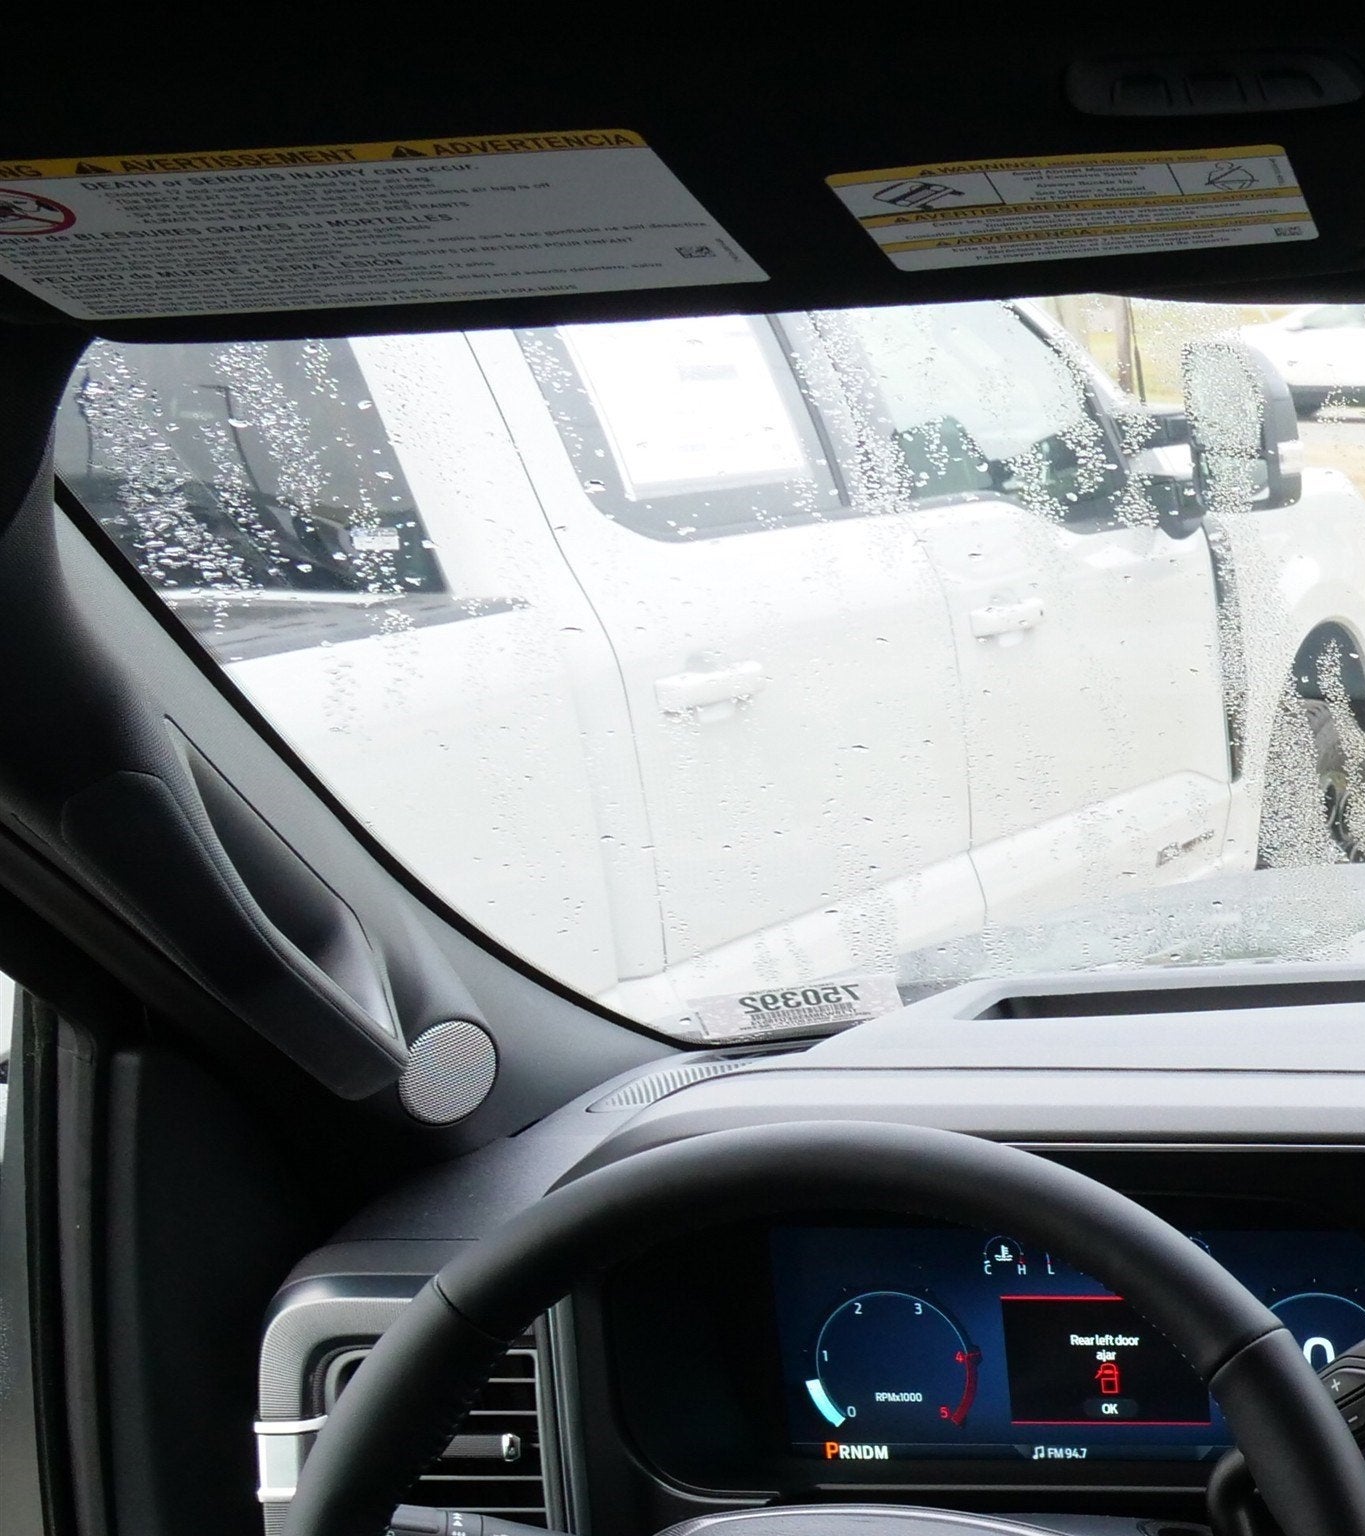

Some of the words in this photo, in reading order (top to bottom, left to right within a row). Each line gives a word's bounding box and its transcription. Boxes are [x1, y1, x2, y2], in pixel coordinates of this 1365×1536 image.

[432, 133, 635, 157] ADVERTENCIA
[119, 148, 358, 173] AVERTISSEMENT
[80, 178, 158, 191] DEATH
[186, 172, 286, 186] SERIOUS
[288, 168, 368, 180] INJURY
[1017, 1264, 1027, 1275] H
[854, 1303, 862, 1315] 2
[914, 1303, 922, 1315] 3
[1070, 1335, 1095, 1346] Rear
[1095, 1335, 1114, 1346] left
[1114, 1335, 1139, 1346] door
[822, 1350, 828, 1362] 1
[955, 1351, 963, 1362] 4
[1096, 1349, 1116, 1362] ajar
[847, 1406, 856, 1418] 0
[940, 1407, 948, 1419] 5
[1101, 1403, 1118, 1415] OK
[1047, 1448, 1064, 1459] FM
[1065, 1447, 1087, 1459] 94.7
